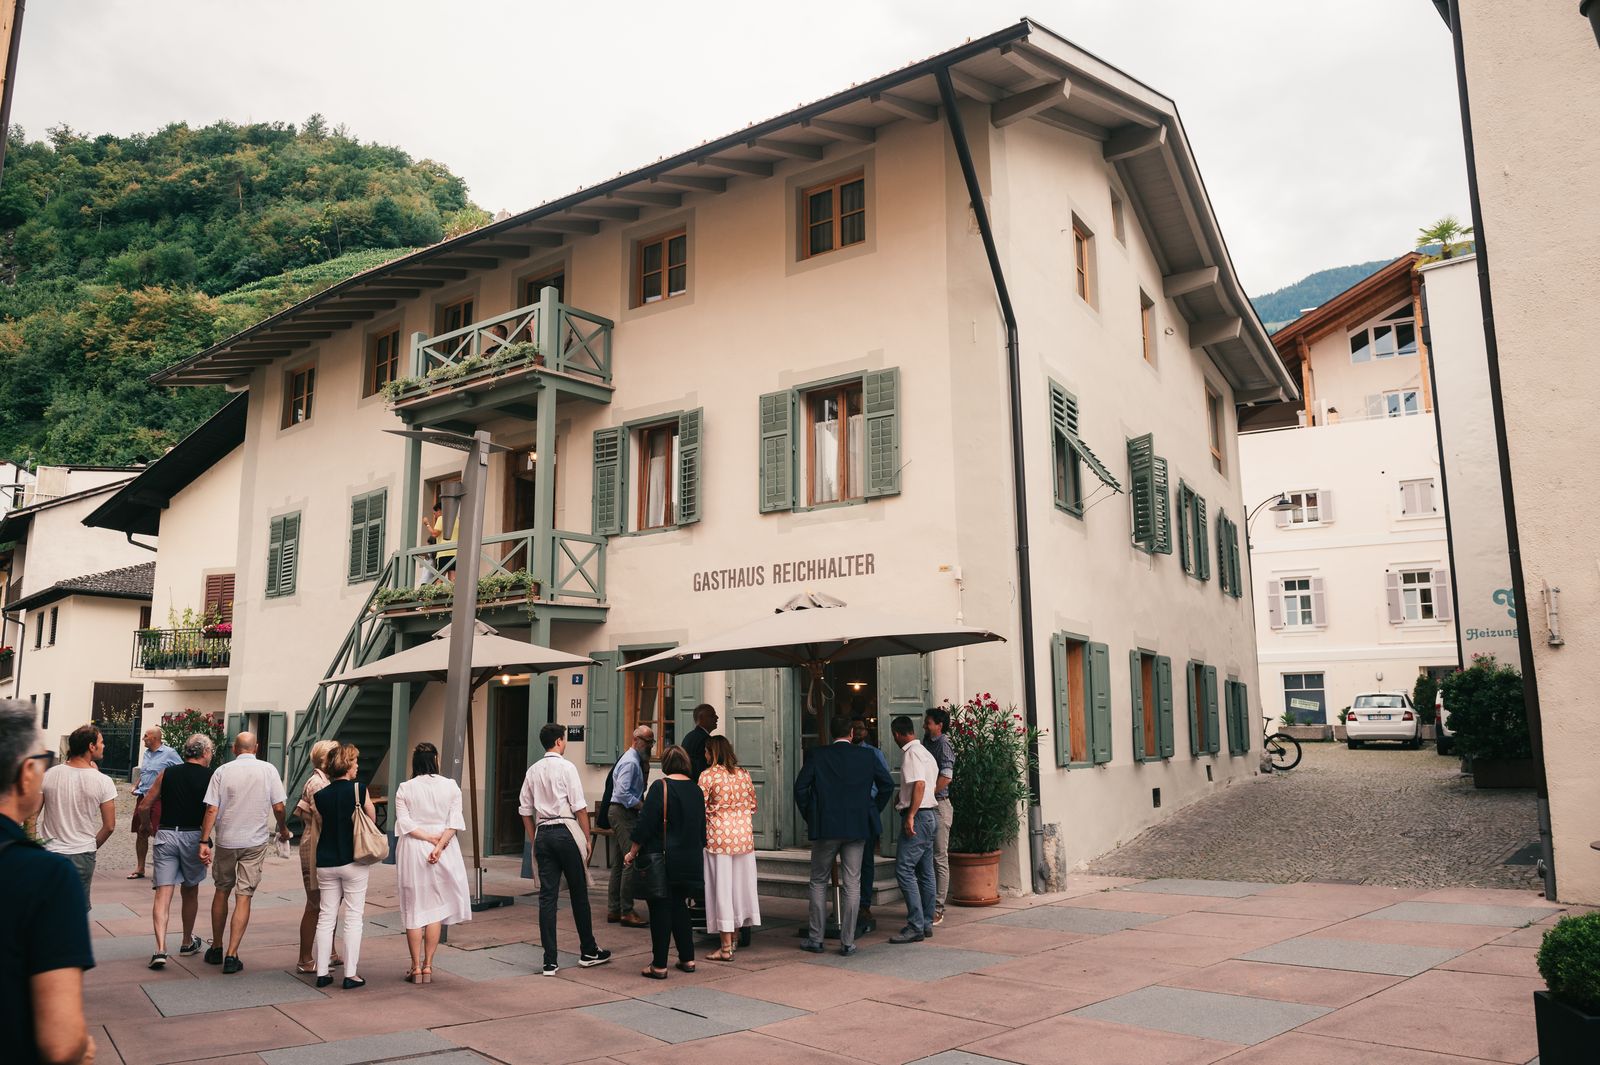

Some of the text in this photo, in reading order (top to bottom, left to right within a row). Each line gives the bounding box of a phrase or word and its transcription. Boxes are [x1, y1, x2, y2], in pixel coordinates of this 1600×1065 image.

[693, 553, 875, 592] GASTHAUS REICHHALTER
[570, 699, 582, 709] RH
